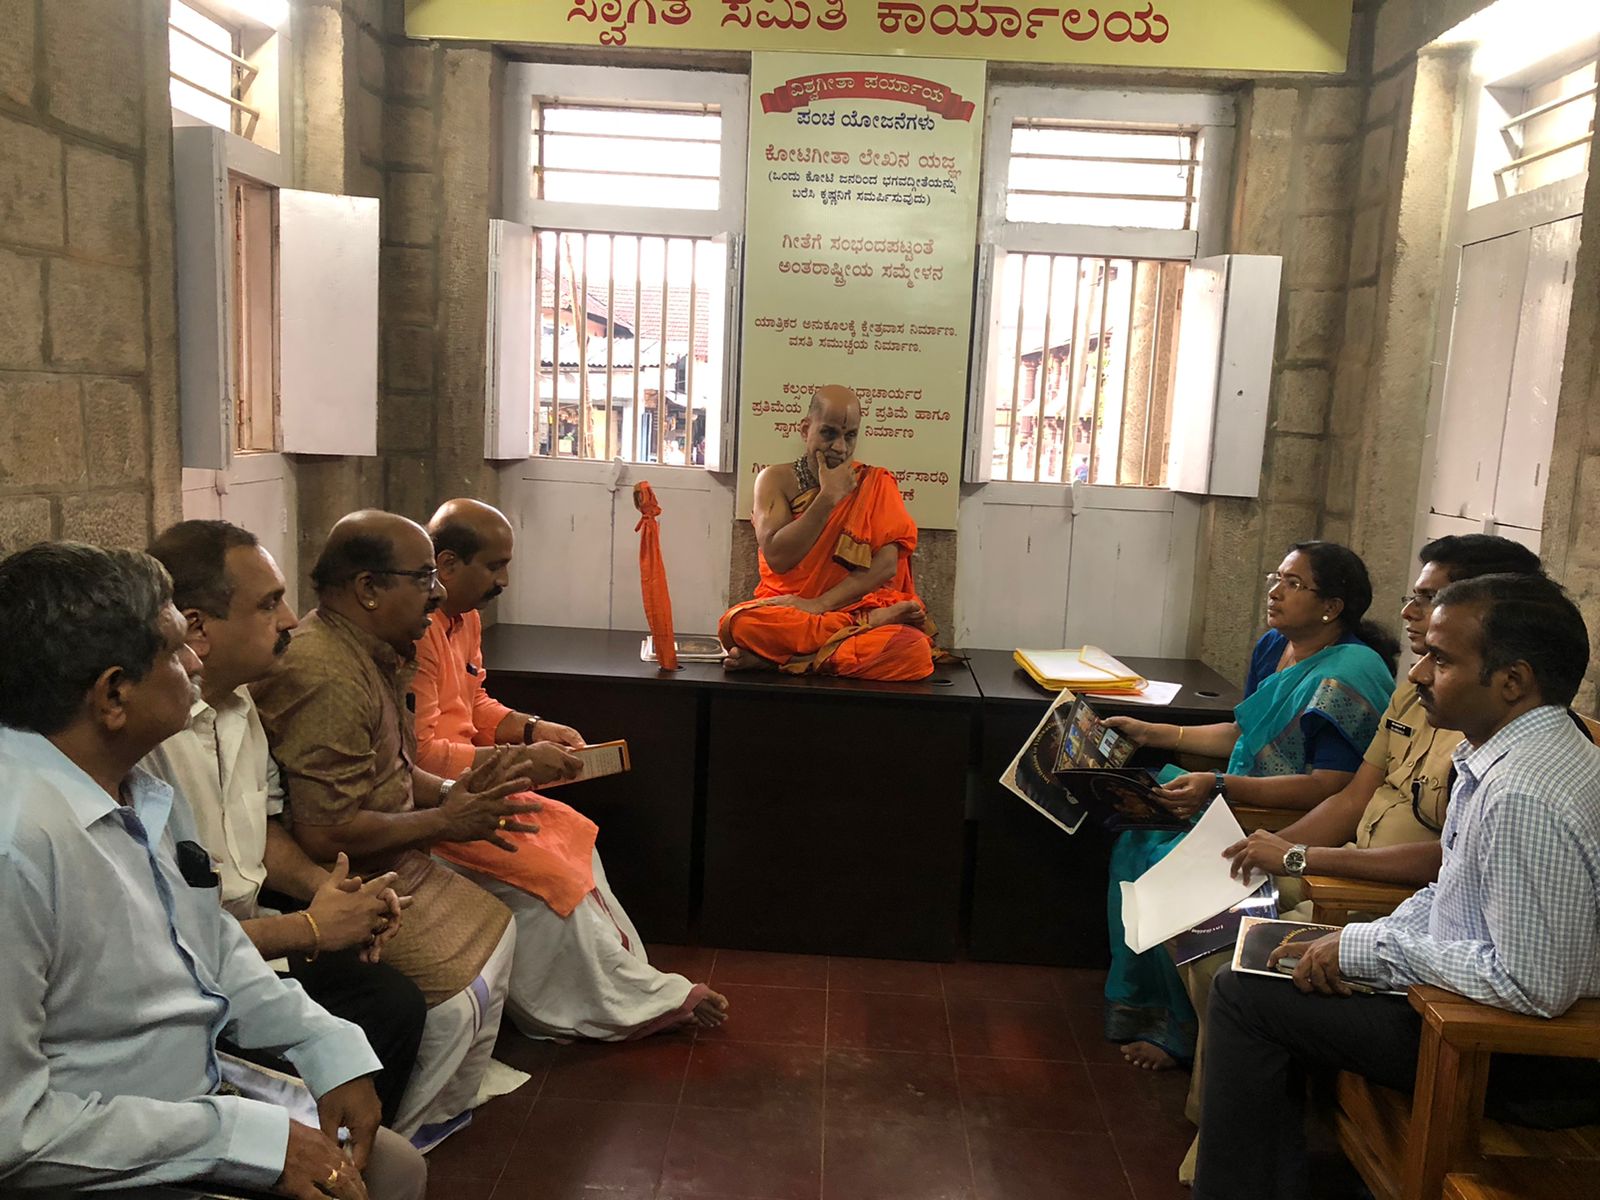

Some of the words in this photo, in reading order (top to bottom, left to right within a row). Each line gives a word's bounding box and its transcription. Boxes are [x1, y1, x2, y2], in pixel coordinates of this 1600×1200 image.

[721, 0, 848, 30] ಸಮಿತಿ
[877, 0, 1170, 43] ಕಾರ್ಯಾಲಯ
[864, 75, 945, 103] ಪರ್ಯಾಯ
[797, 109, 836, 127] ಪಂಚ
[841, 110, 936, 131] ಯೋಜನೆಗಳು
[765, 144, 850, 165] ಕೋಟಿಗೀತಾ
[859, 148, 910, 168] ಲೇಖನ
[805, 170, 835, 184] ಕೋಟಿ
[839, 173, 878, 186] ಜನರಿಂದ
[782, 233, 822, 249] ಗೀತೆಗೆ
[881, 262, 944, 289] ಸಮ್ಮೇಳನ
[755, 316, 798, 333] ಯಾತ್ರಿಕರ
[788, 336, 813, 347] ವಸತಿ
[848, 386, 922, 405] ಧ್ವಾಚಾರ್ಯರ
[915, 408, 951, 421] ಹಾಗೂ
[865, 425, 915, 439] ನಿರ್ಮಾಣ
